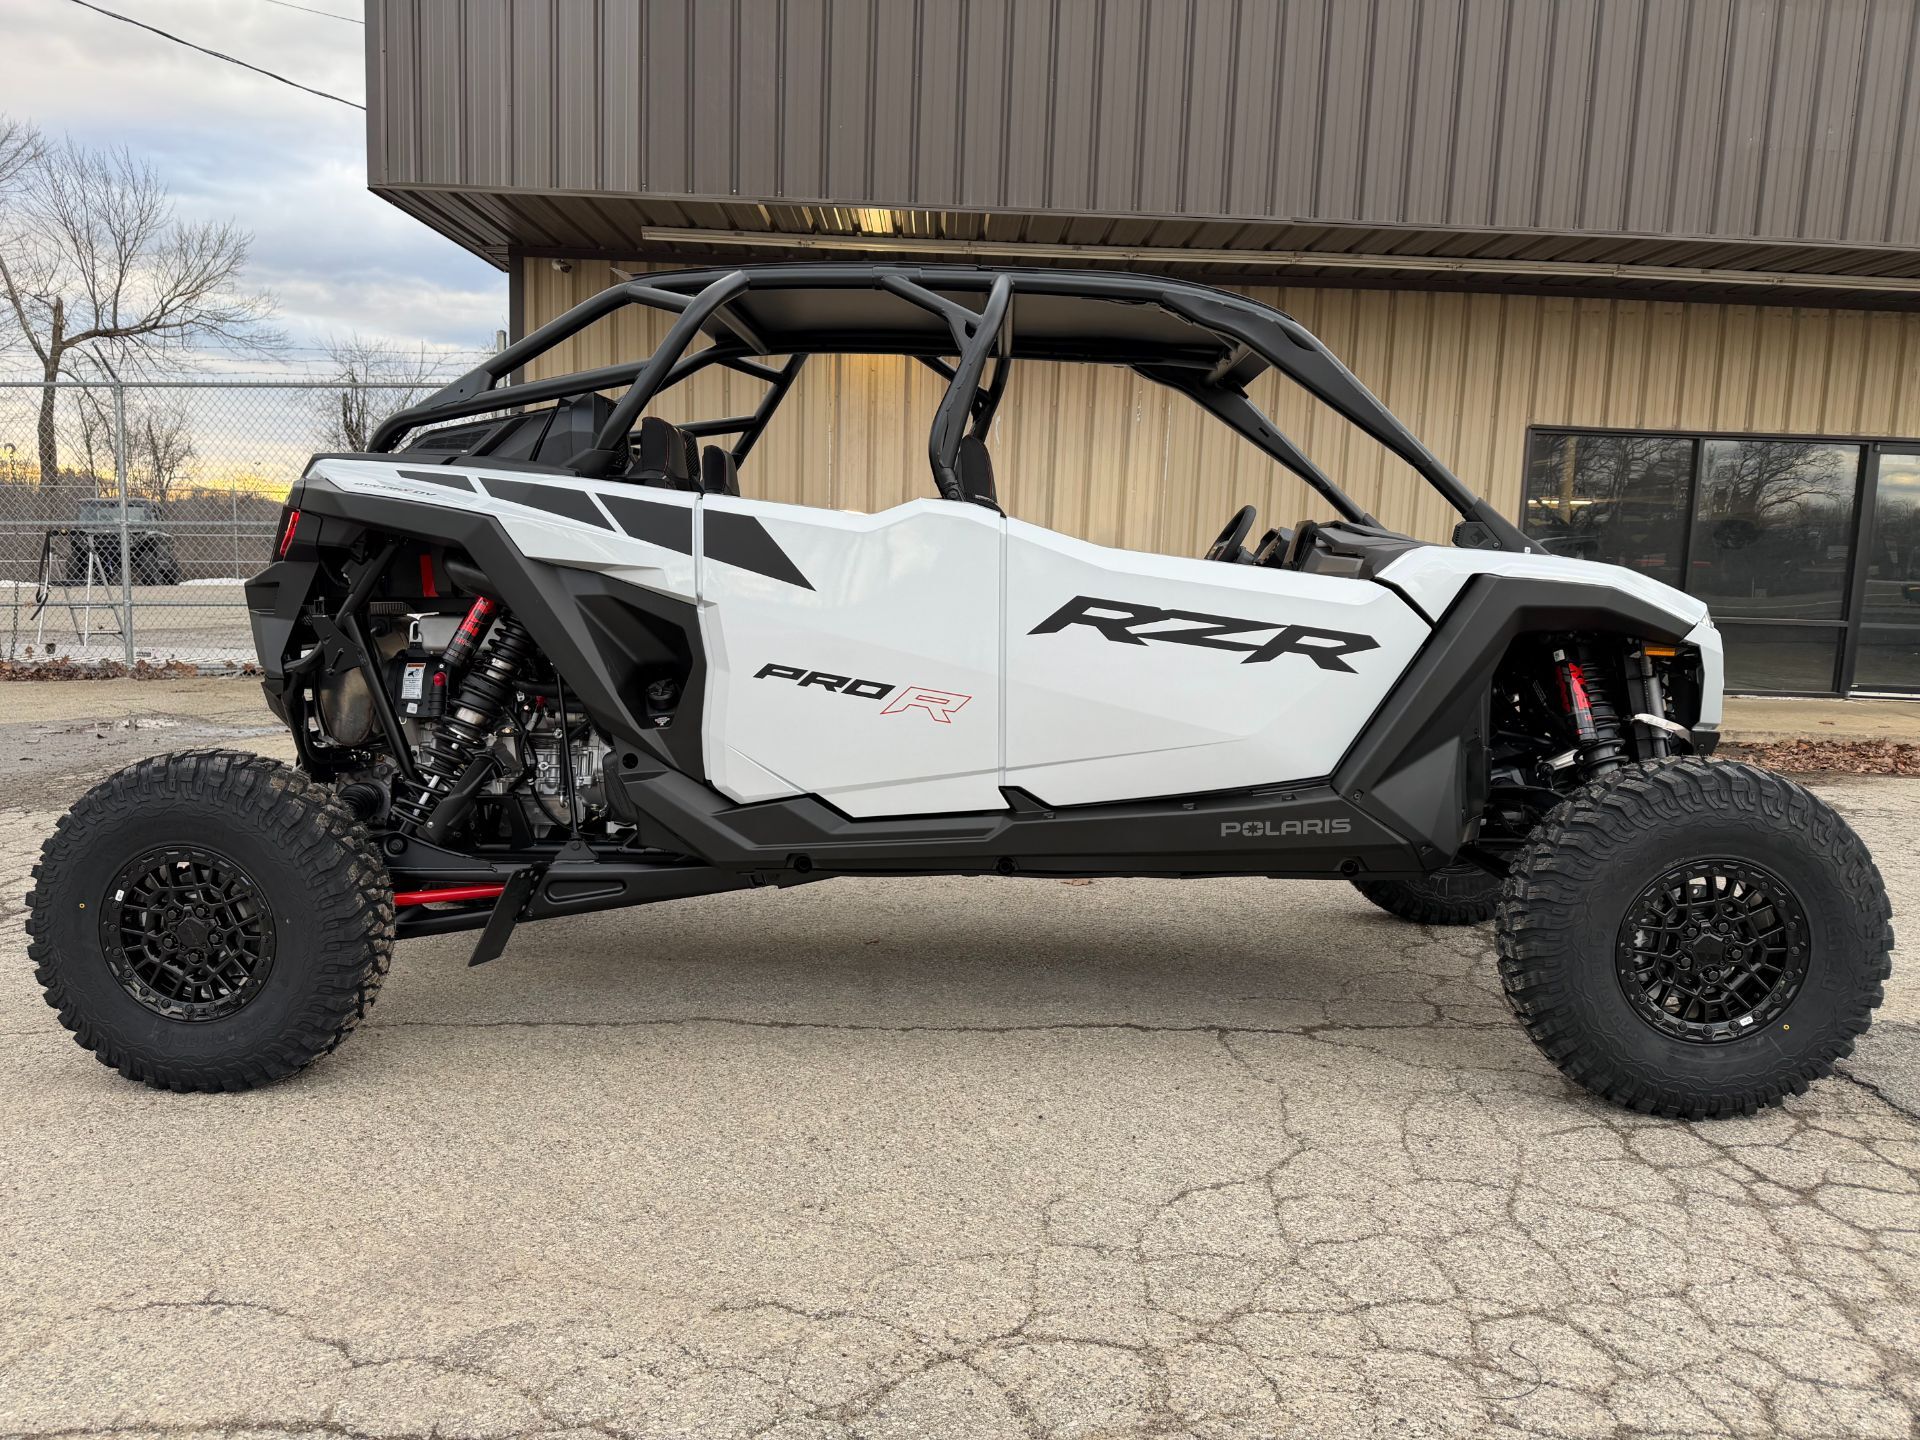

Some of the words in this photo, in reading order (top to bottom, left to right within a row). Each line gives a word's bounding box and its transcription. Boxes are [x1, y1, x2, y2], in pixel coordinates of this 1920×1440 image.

[1026, 595, 1381, 674] RZR
[753, 663, 896, 700] PRO
[880, 686, 972, 723] R
[1220, 818, 1352, 837] POLARIS
